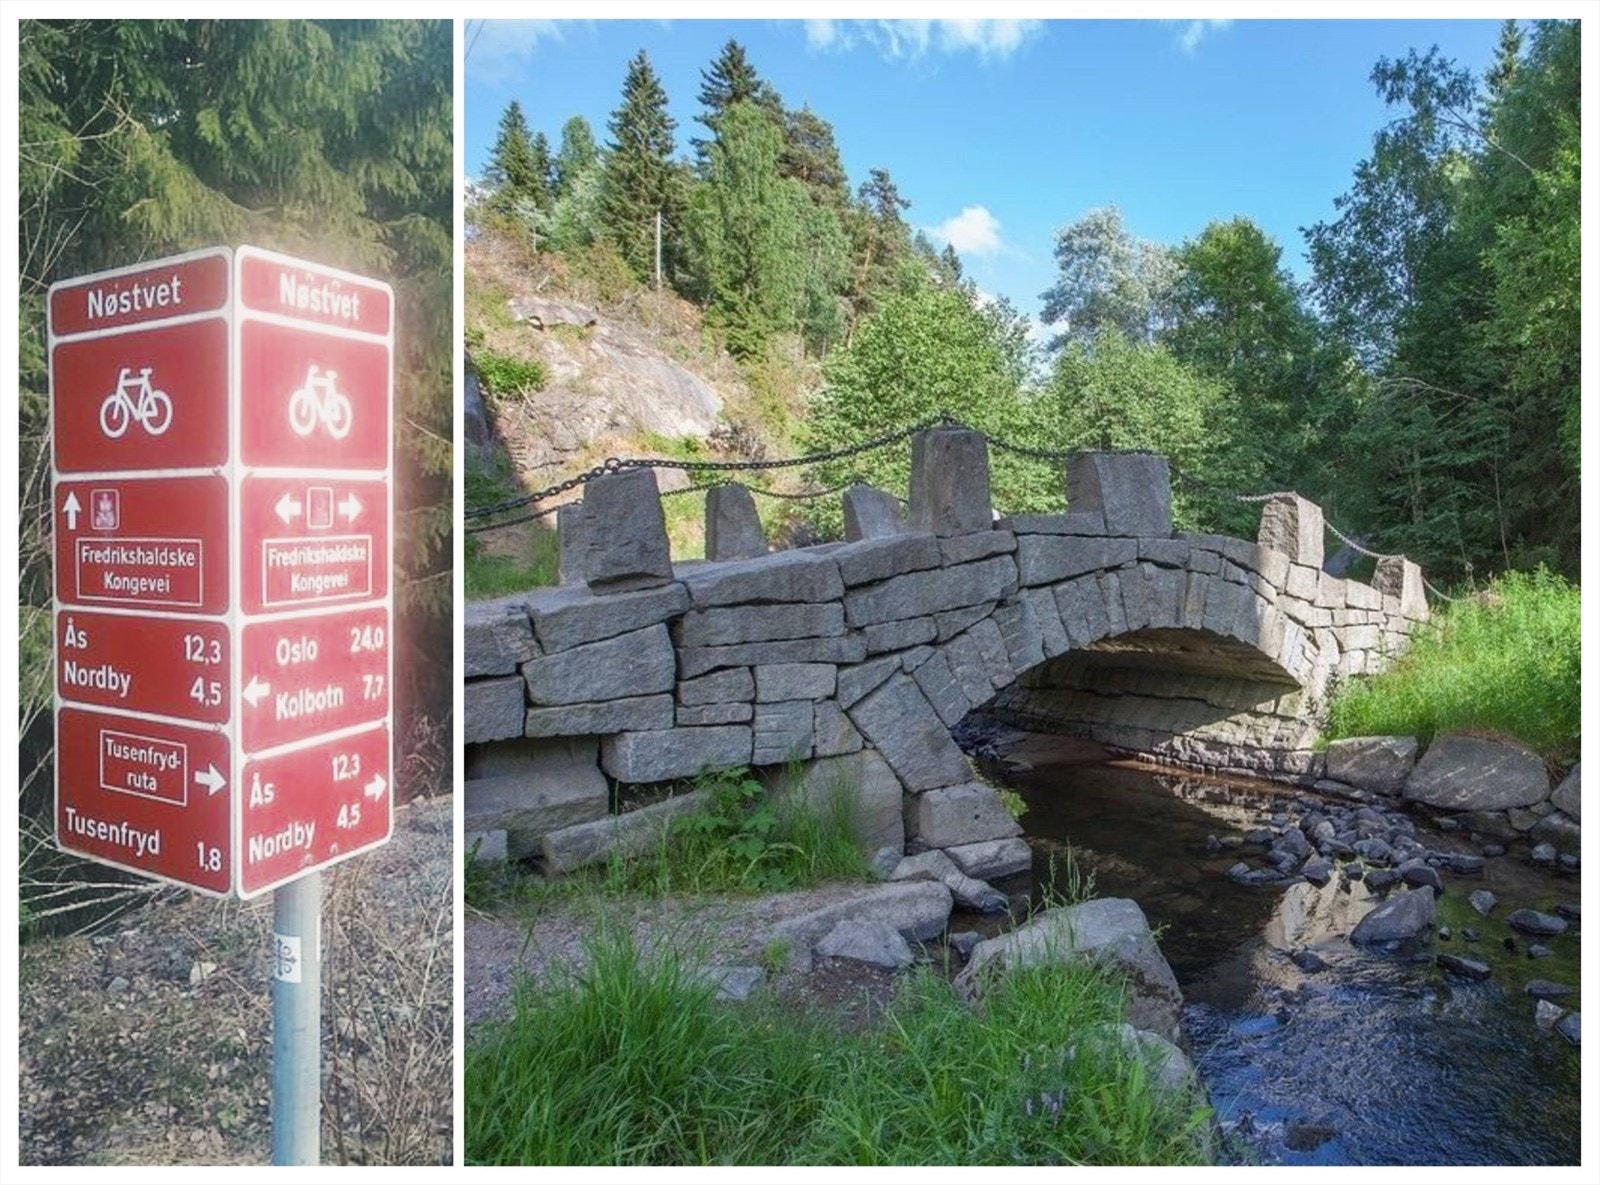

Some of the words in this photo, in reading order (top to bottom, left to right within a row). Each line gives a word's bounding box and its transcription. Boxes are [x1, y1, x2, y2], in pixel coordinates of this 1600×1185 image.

[87, 274, 181, 318] Nøstvet
[279, 272, 361, 320] Nøstvet
[81, 545, 196, 566] Fredrikshaldske
[267, 544, 367, 567] Fredrikshaldske
[103, 571, 171, 594] Kongevei
[291, 570, 349, 593] Kongevei
[64, 617, 88, 649] Ås
[183, 634, 221, 664] 12,3
[275, 637, 318, 666] Oslo
[64, 660, 132, 698] Nordby
[190, 677, 222, 707] 4,5
[276, 684, 344, 720] Kolbotn
[126, 770, 157, 791] ruta
[249, 772, 275, 808] Ås
[65, 806, 161, 857] Tusenfryd
[197, 842, 222, 872] 1,8
[249, 821, 315, 864] Nordby
